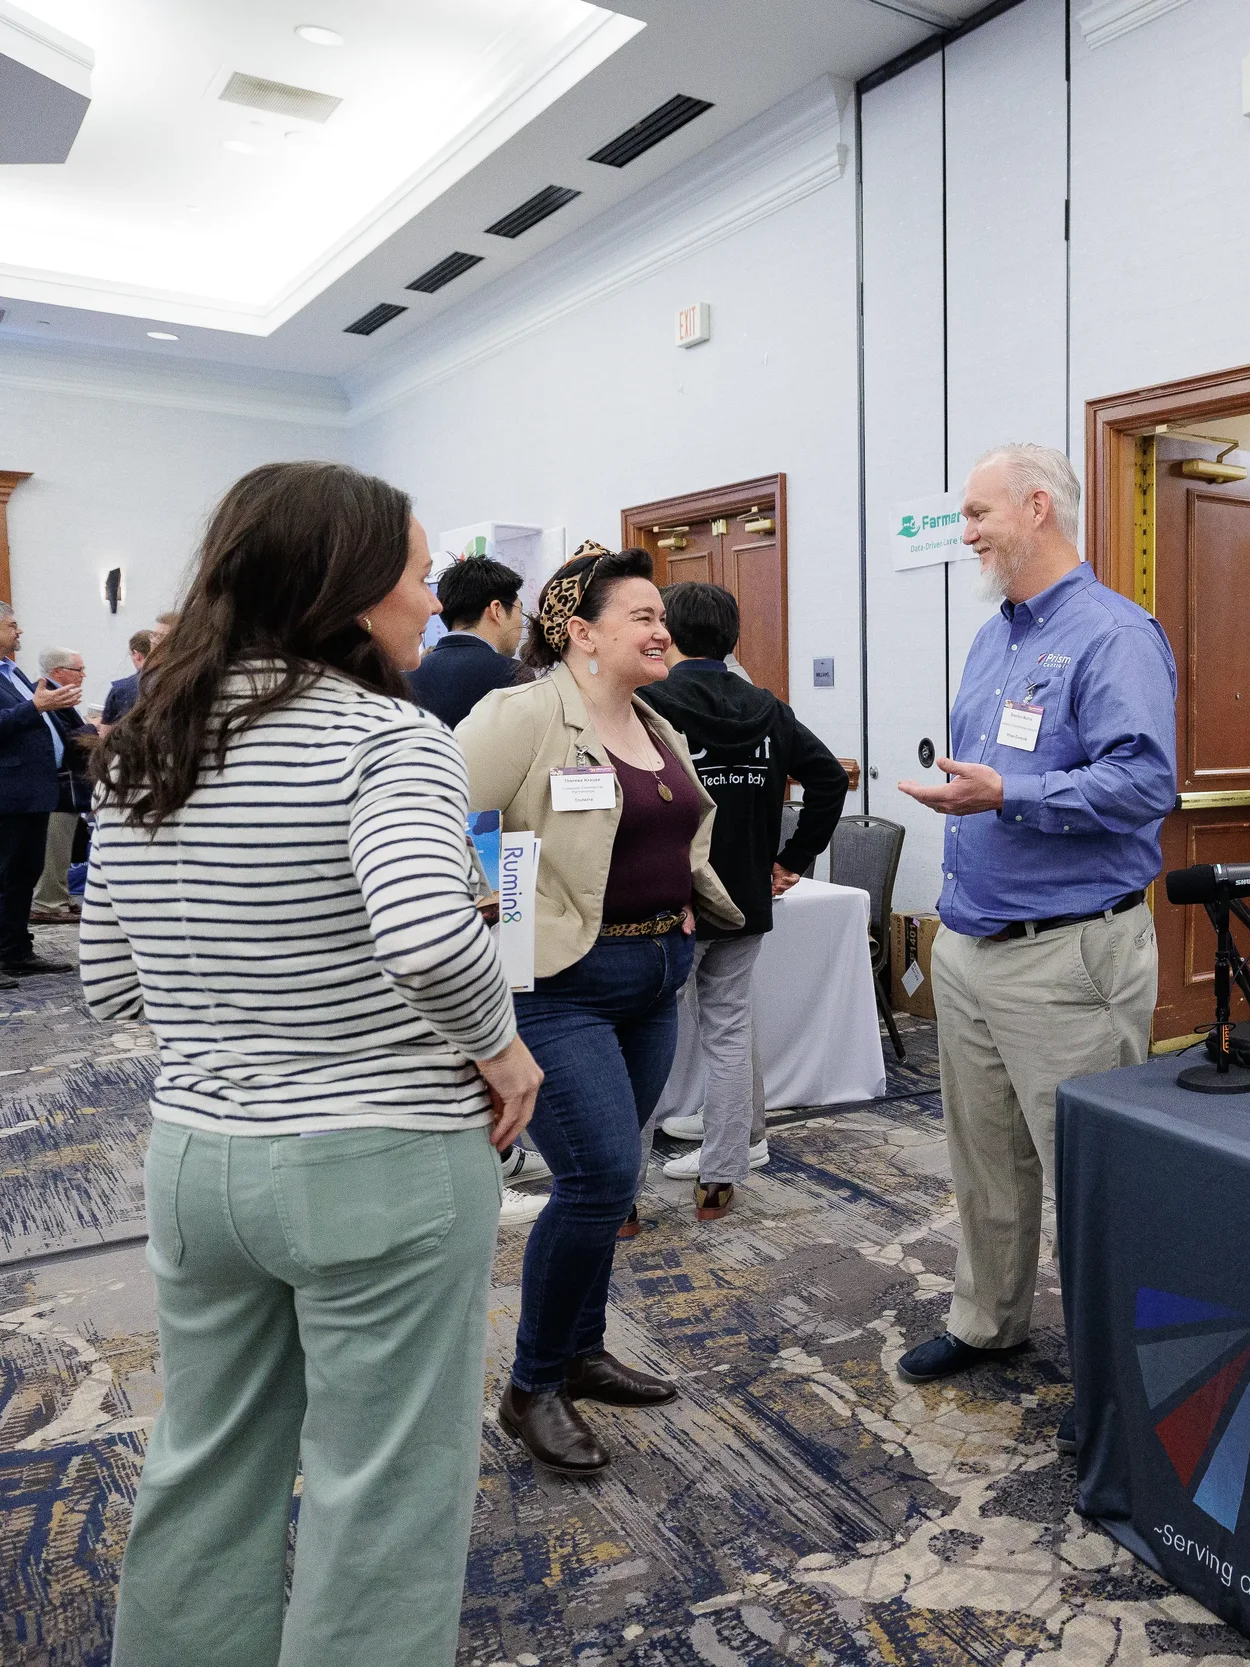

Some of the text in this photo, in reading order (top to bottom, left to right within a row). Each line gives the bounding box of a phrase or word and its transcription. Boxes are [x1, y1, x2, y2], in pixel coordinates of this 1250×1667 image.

[679, 305, 696, 340] EXIT
[1045, 653, 1072, 664] Prism
[729, 772, 744, 784] for
[502, 846, 523, 924] Rumin8
